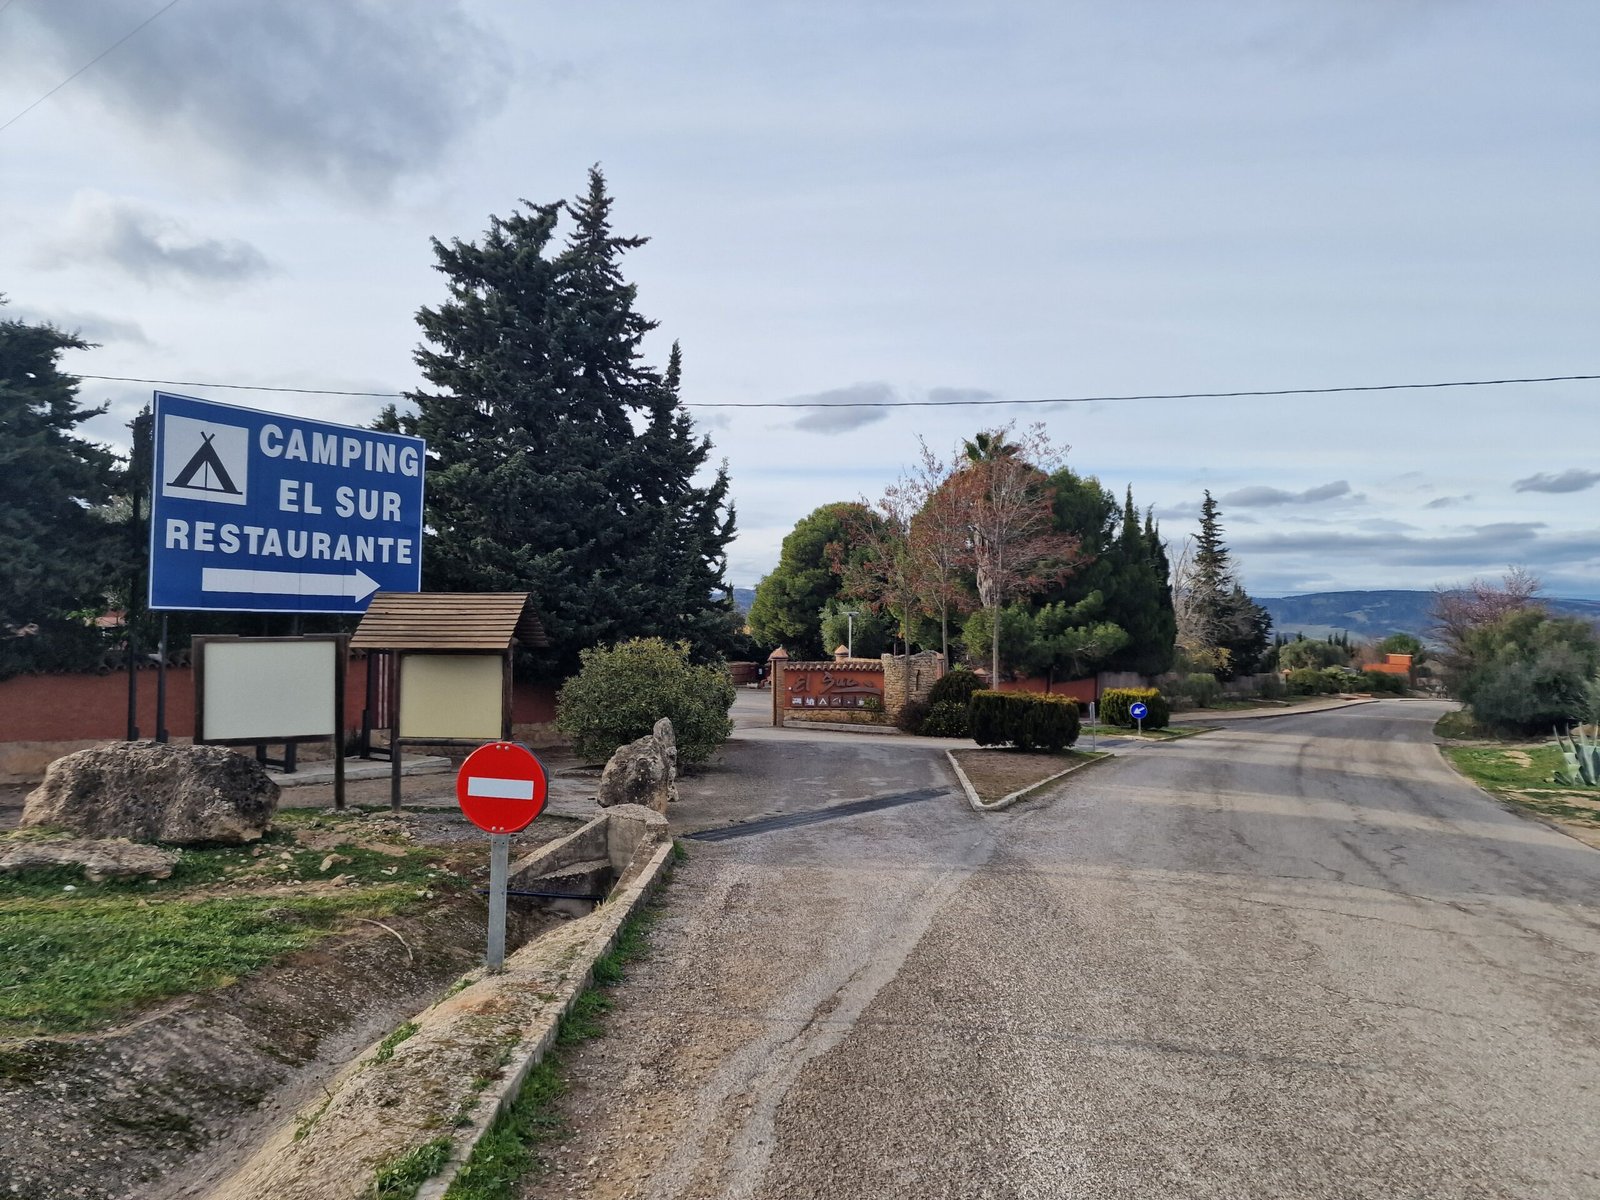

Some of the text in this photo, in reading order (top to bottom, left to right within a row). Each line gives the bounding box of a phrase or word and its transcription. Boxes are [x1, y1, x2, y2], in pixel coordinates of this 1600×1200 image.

[259, 423, 419, 477] CAMPING
[279, 478, 402, 522] EL SUR
[166, 518, 412, 564] RESTAURANTE
